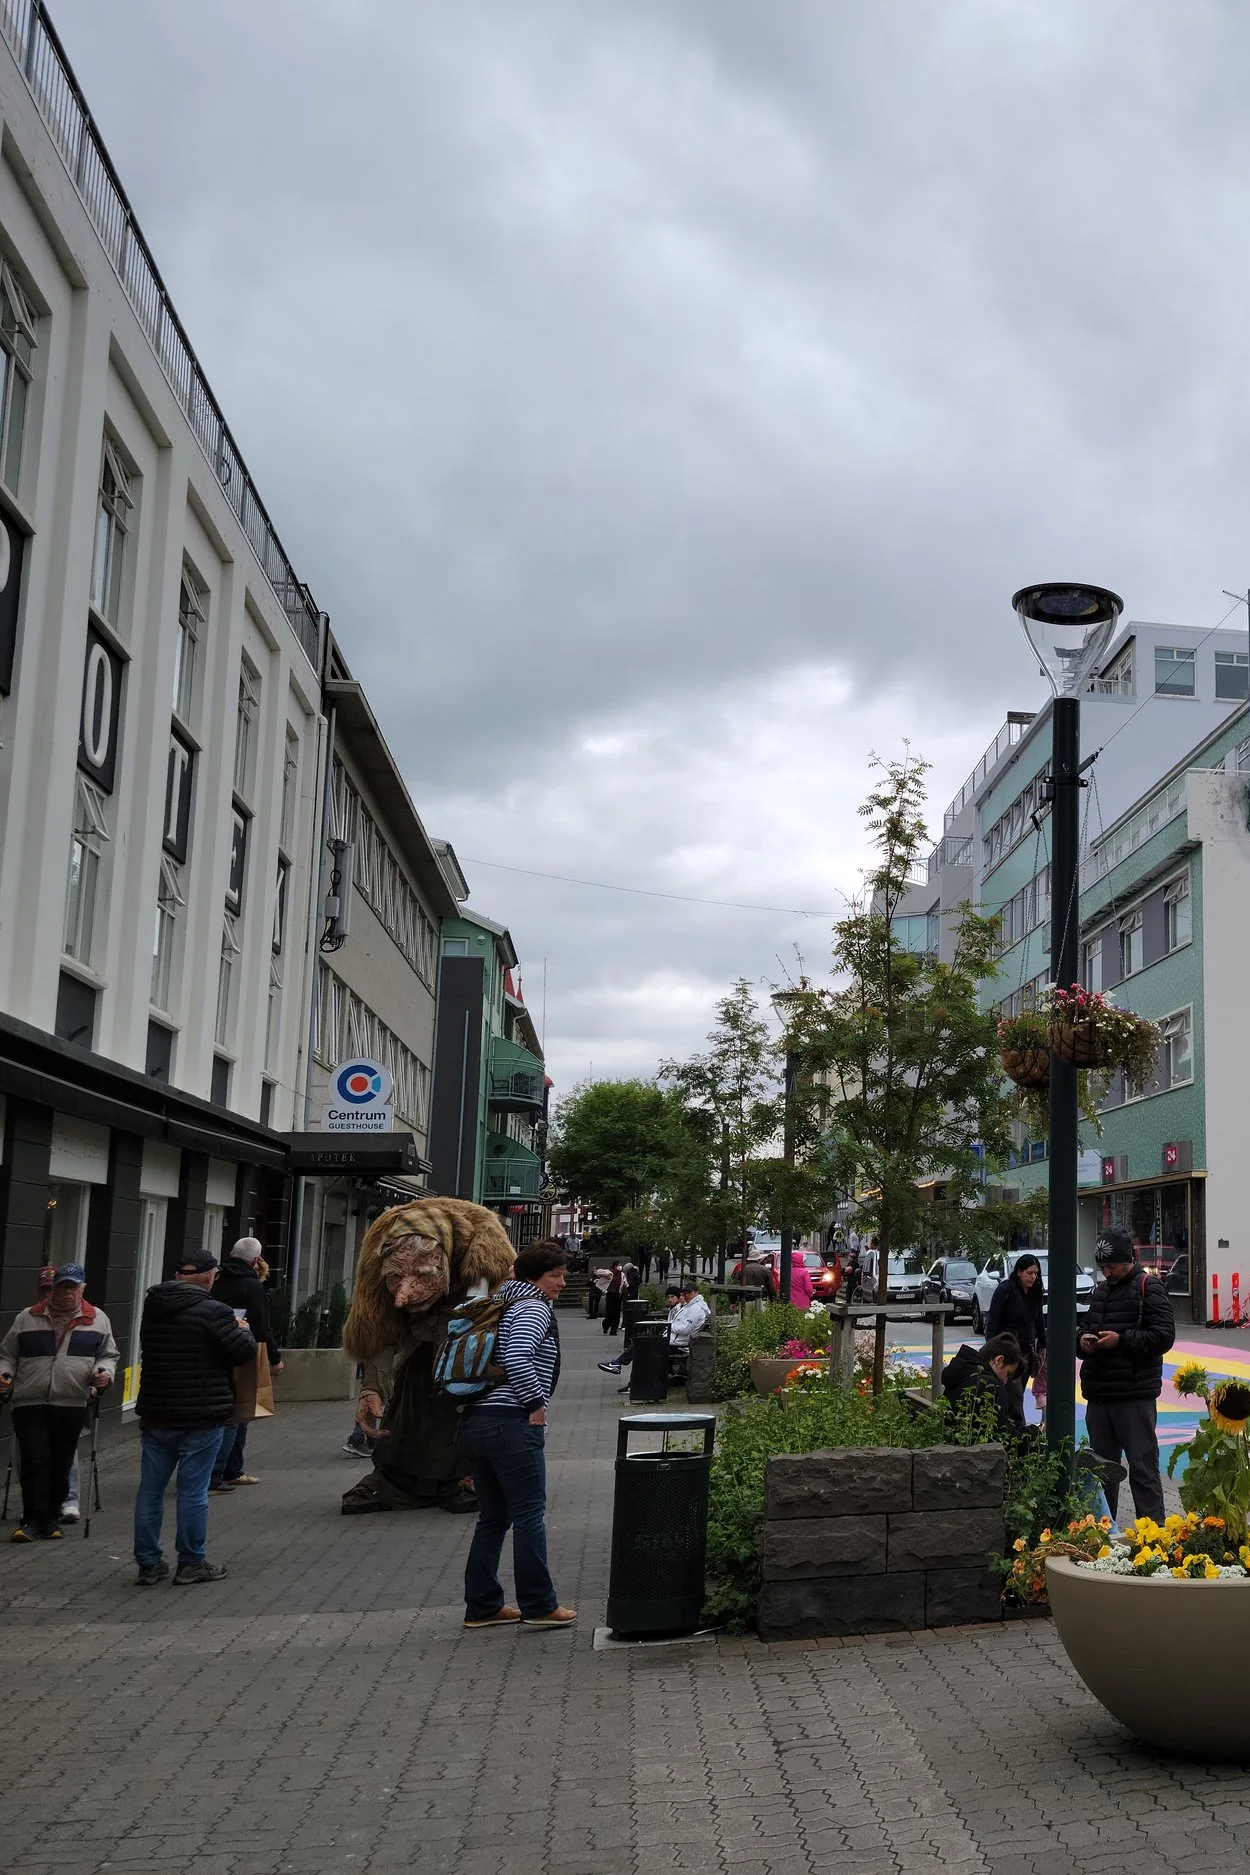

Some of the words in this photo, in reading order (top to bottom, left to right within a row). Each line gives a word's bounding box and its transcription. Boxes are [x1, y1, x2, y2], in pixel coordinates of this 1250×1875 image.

[328, 1110, 386, 1120] Centrum
[310, 1152, 357, 1162] APOTEK
[1167, 1150, 1176, 1161] 24
[1105, 1165, 1113, 1175] 24
